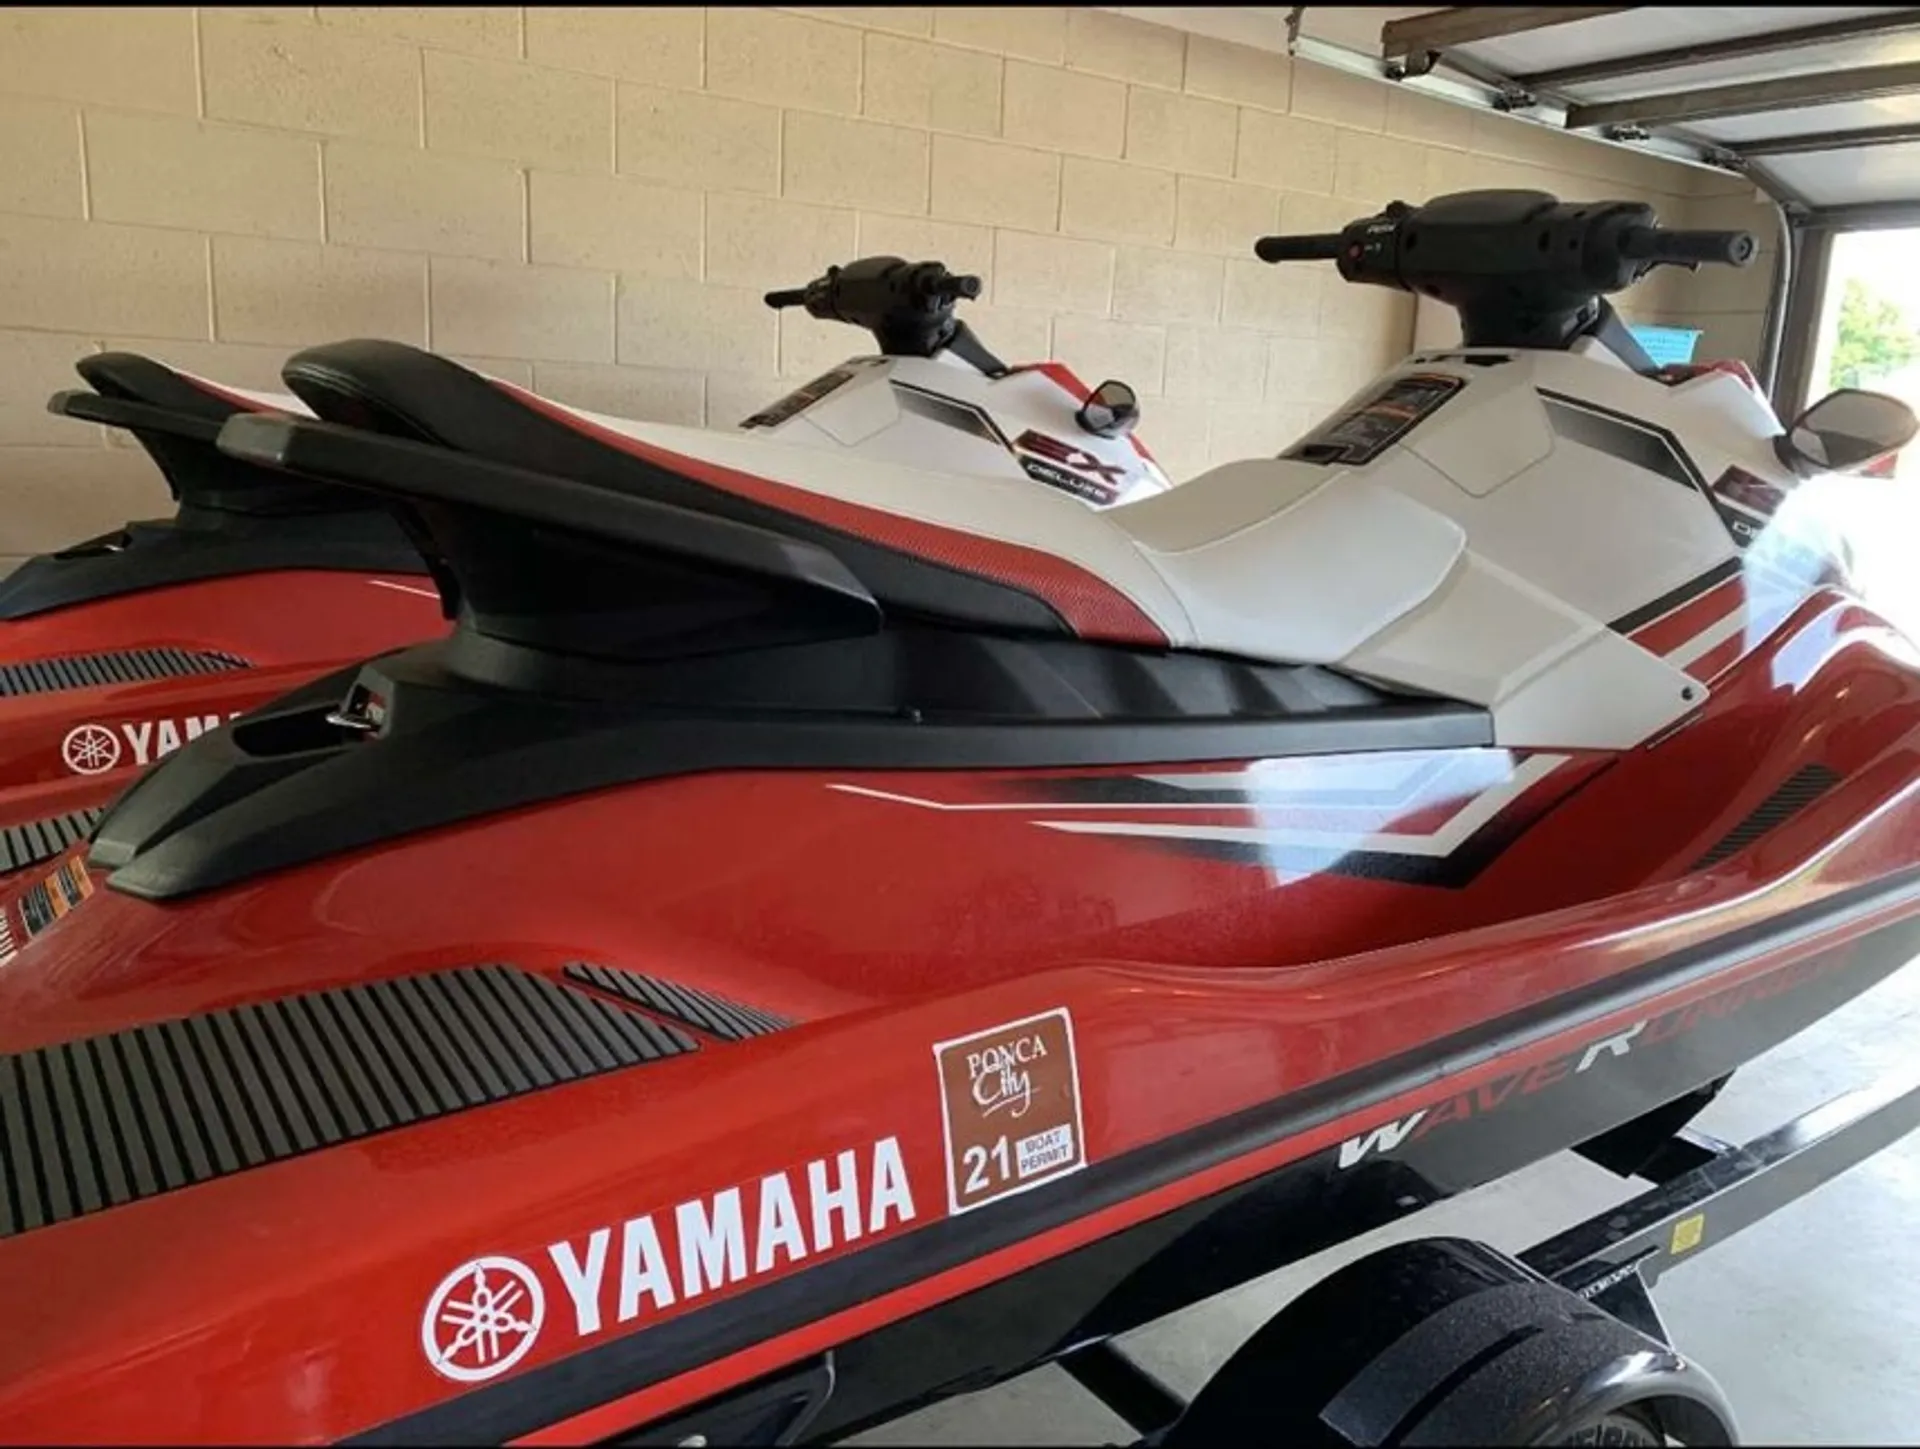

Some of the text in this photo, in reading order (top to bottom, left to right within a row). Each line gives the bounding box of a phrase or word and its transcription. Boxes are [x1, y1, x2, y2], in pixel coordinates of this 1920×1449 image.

[121, 711, 242, 766] YAM
[966, 1034, 1048, 1079] PONCA
[972, 1062, 1041, 1118] City
[962, 1134, 1010, 1195] 21
[1020, 1143, 1069, 1172] PERMIT
[1025, 1130, 1061, 1153] BOAT
[548, 1135, 916, 1336] YAMAHA
